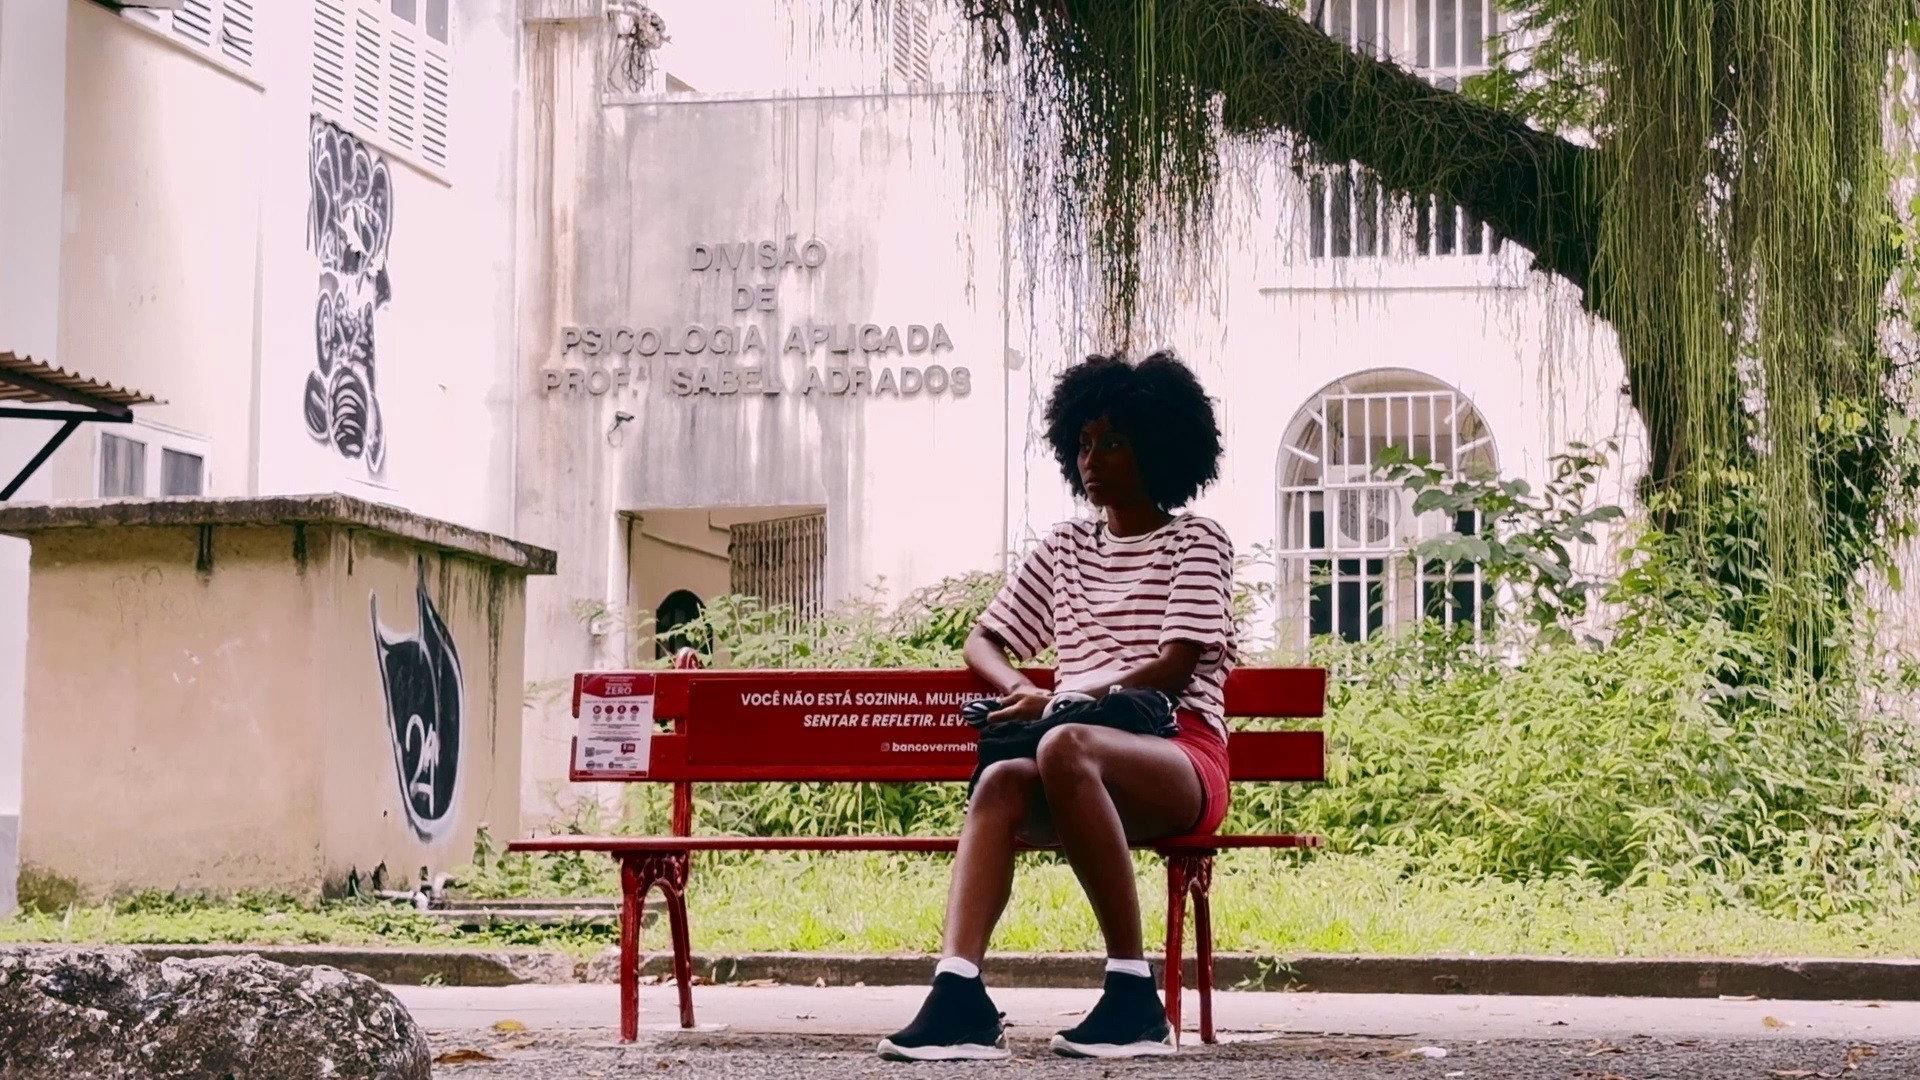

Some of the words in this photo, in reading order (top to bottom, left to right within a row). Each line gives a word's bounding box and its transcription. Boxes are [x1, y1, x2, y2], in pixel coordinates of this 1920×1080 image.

[690, 235, 827, 272] DIVISÃO
[732, 284, 776, 312] DE
[561, 325, 765, 357] PSICOLOGIA
[783, 323, 955, 357] APLICADA
[803, 365, 972, 399] ADRADOS
[605, 687, 632, 695] ZERO
[741, 690, 780, 706] VOCÊ
[783, 690, 815, 706] NÃO
[818, 689, 852, 706] ESTÁ
[855, 692, 922, 706] SOZINHA.
[803, 713, 857, 728] SENTAR
[860, 714, 869, 727] E
[872, 713, 936, 727] REFLETIR.
[939, 713, 969, 727] LEV
